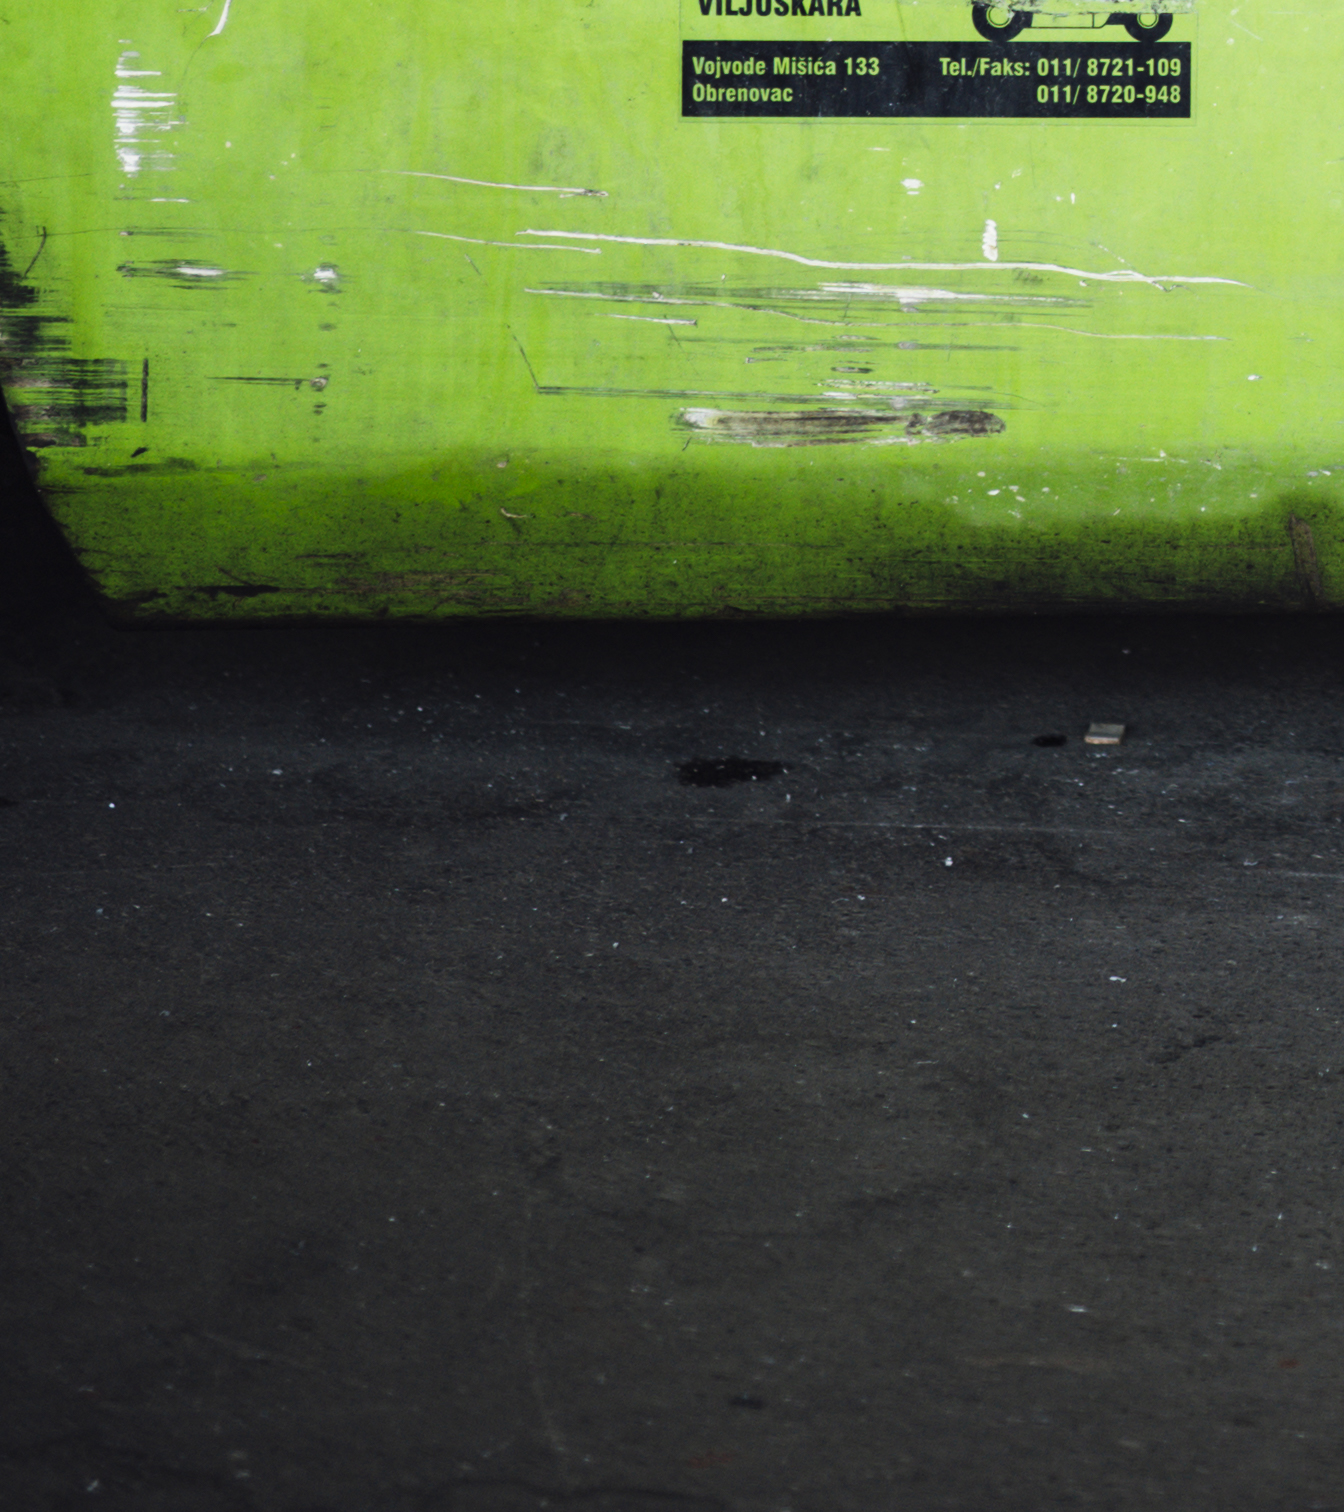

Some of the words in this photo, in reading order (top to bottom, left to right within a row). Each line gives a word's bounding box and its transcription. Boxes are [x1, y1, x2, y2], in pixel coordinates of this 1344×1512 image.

[691, 56, 766, 80] Vojvode
[773, 56, 837, 76] Mišića
[844, 56, 880, 76] 133
[939, 57, 1030, 77] Tel./Faks:
[1037, 57, 1081, 77] 011/
[1086, 57, 1182, 77] 8721-109
[692, 83, 793, 103] Obrenovac
[1036, 84, 1081, 104] 011/
[1086, 84, 1181, 104] 8720-948
